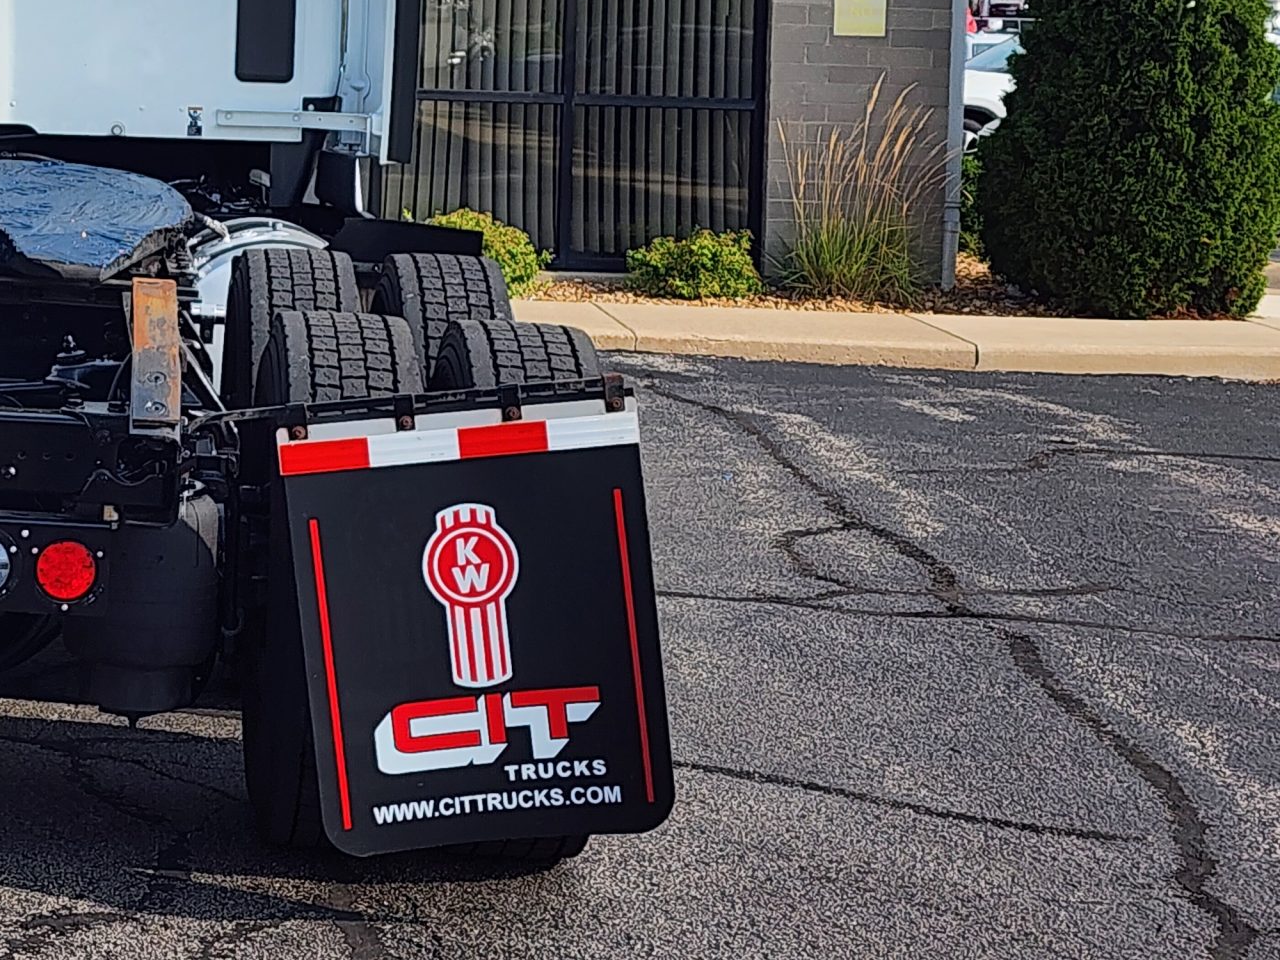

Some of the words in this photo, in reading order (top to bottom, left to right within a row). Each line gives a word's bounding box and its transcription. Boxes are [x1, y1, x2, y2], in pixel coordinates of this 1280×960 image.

[456, 536, 481, 565] K
[452, 565, 490, 593] W
[373, 685, 601, 774] CIT
[504, 759, 607, 781] TRUCKS
[372, 785, 622, 825] WWW.CITTRUCKS.COM
